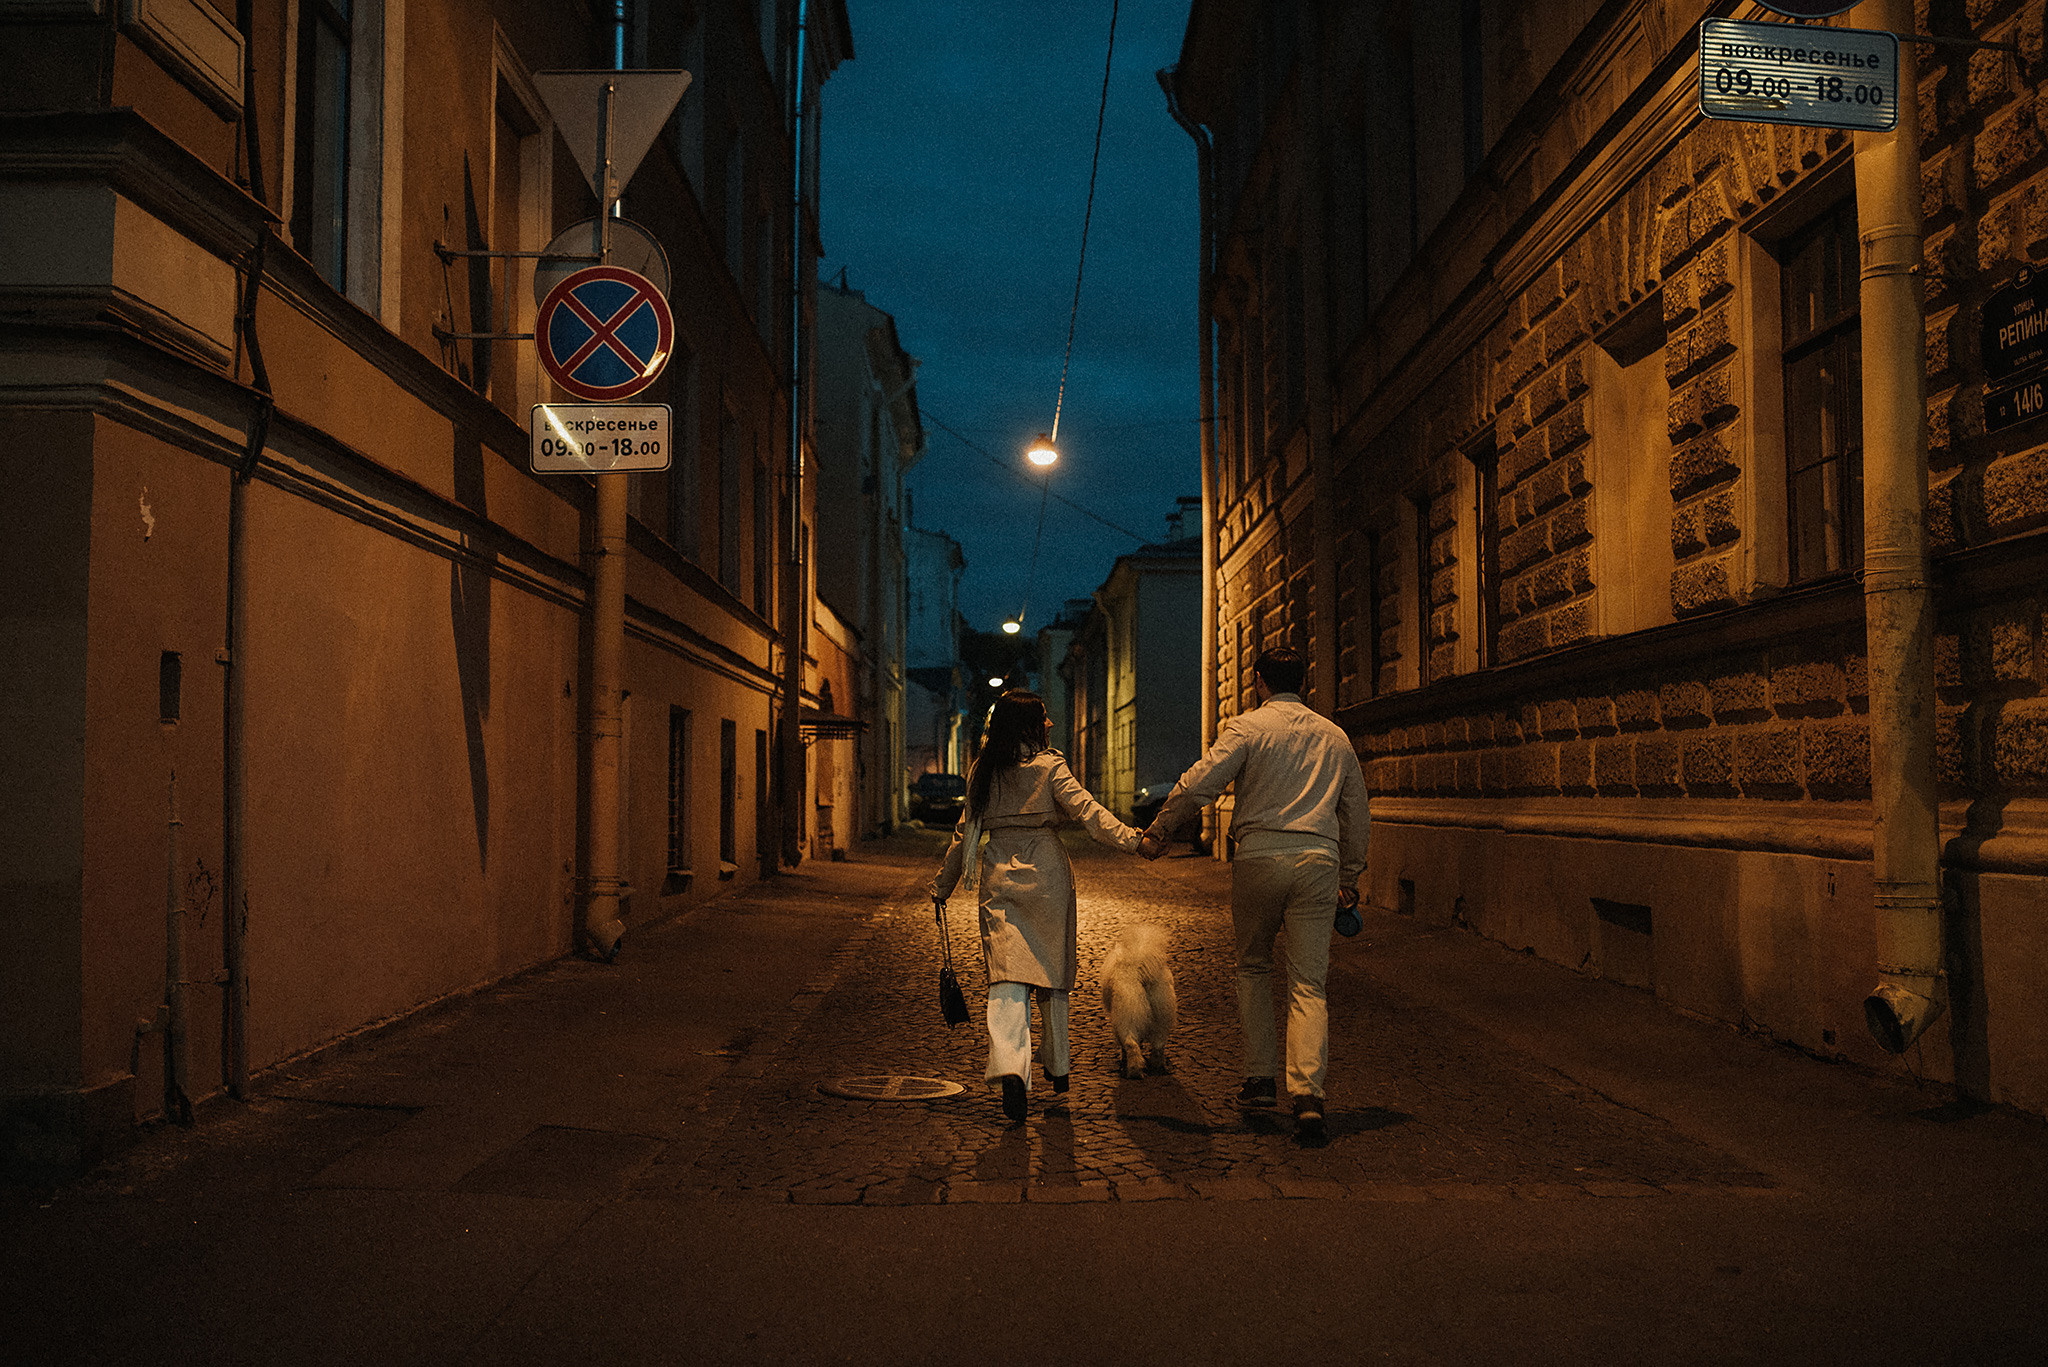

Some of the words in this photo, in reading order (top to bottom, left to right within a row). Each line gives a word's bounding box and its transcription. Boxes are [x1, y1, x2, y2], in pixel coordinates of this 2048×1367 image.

[1721, 43, 1880, 69] воскресенье
[2013, 383, 2044, 417] 14/6
[544, 419, 659, 434] вскресенье
